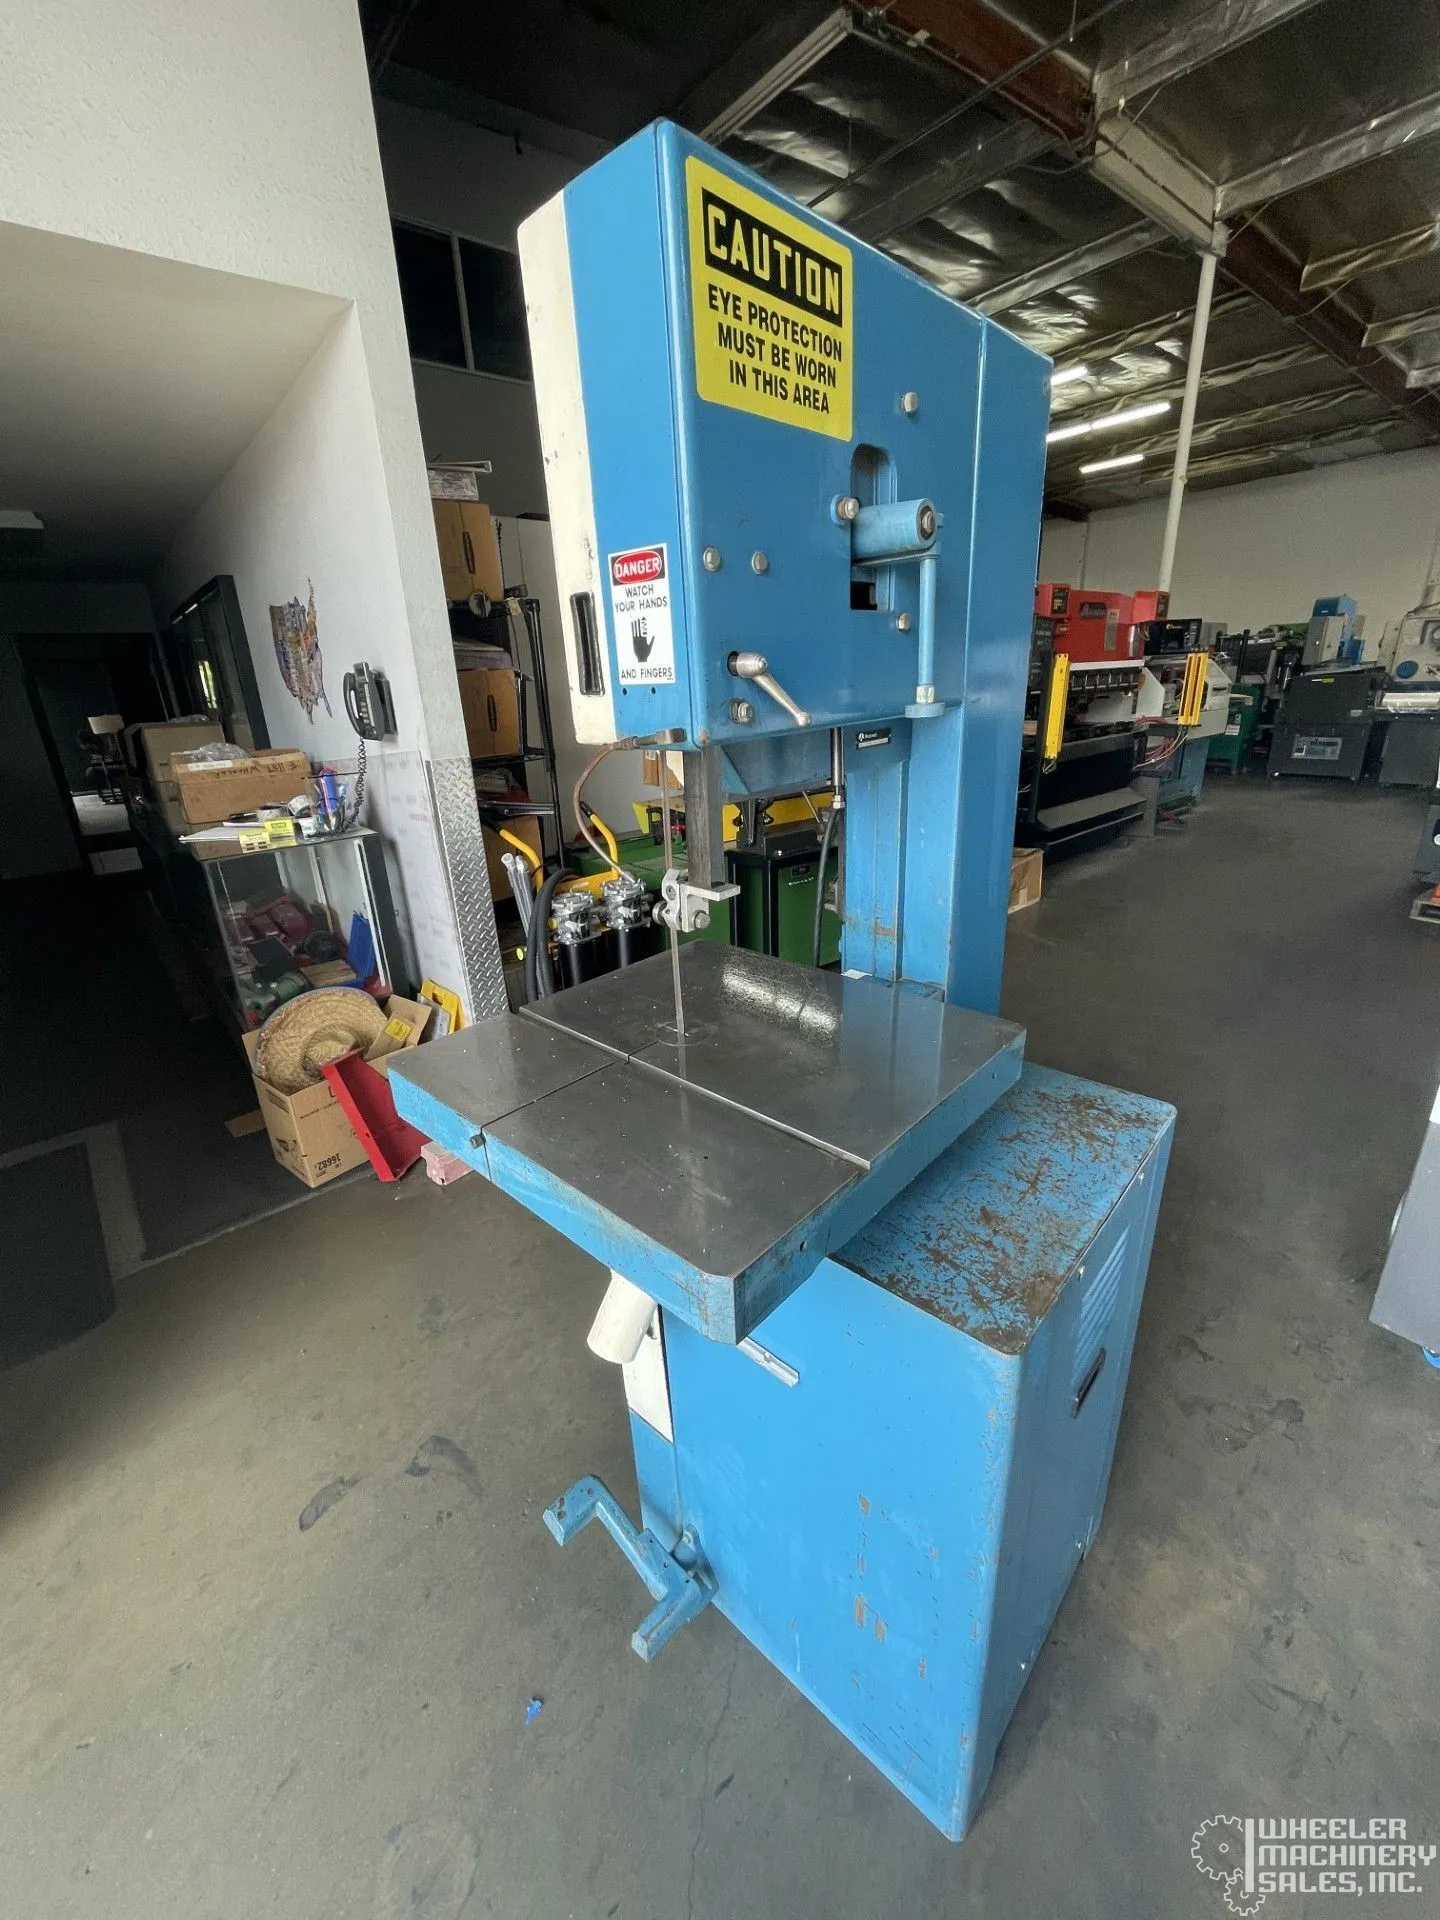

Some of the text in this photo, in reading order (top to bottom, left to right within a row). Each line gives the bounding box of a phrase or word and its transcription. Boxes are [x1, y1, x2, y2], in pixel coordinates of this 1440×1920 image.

[708, 203, 839, 315] CAUTION
[708, 282, 842, 362] EYE PROTECTION
[718, 322, 836, 388] MUST BE WORN
[729, 359, 830, 414] IN THIS AREA
[615, 558, 660, 578] DANGER
[614, 596, 668, 613] YOUR HANDS
[625, 584, 654, 598] WATCH
[621, 667, 673, 680] AND FINGERS
